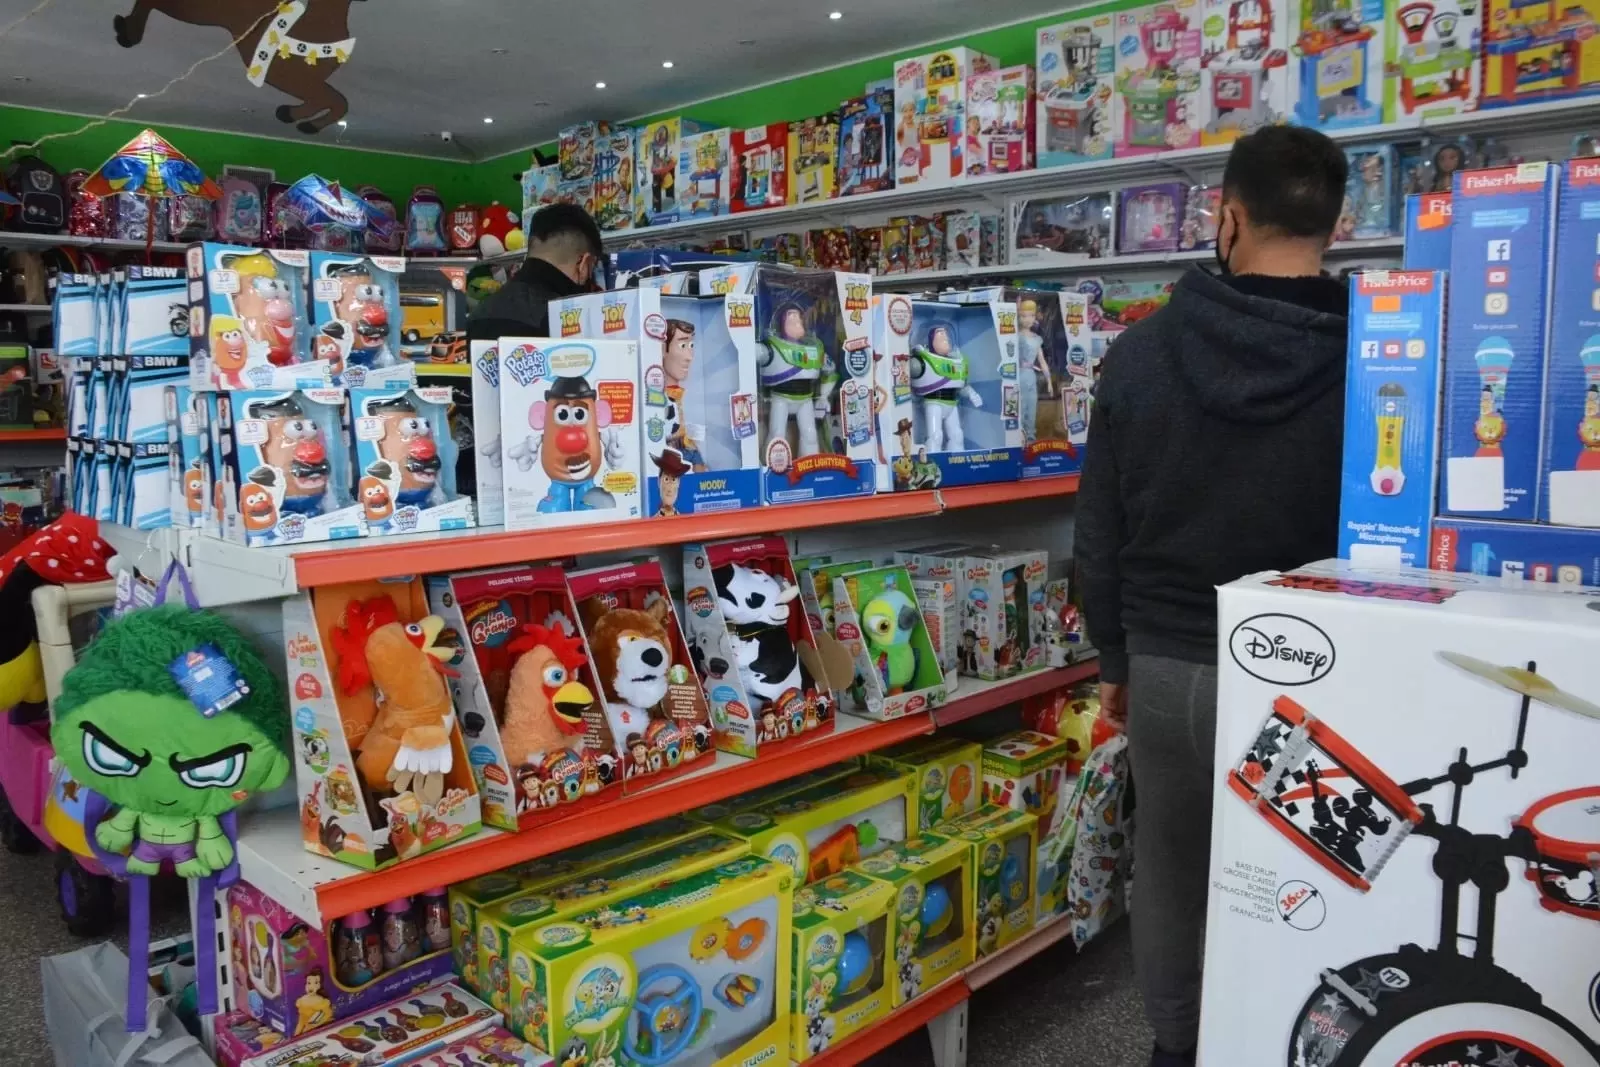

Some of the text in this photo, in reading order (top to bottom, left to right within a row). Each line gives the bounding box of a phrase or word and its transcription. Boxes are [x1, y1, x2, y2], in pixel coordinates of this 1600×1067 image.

[142, 267, 178, 278] BMW
[560, 307, 582, 327] TOY
[602, 303, 627, 322] TOY
[727, 302, 752, 318] TOY
[144, 356, 178, 367] BMW
[506, 350, 546, 375] Potato
[518, 363, 546, 386] Head
[472, 616, 517, 645] Granja
[1234, 860, 1277, 877] BASS DRUM
